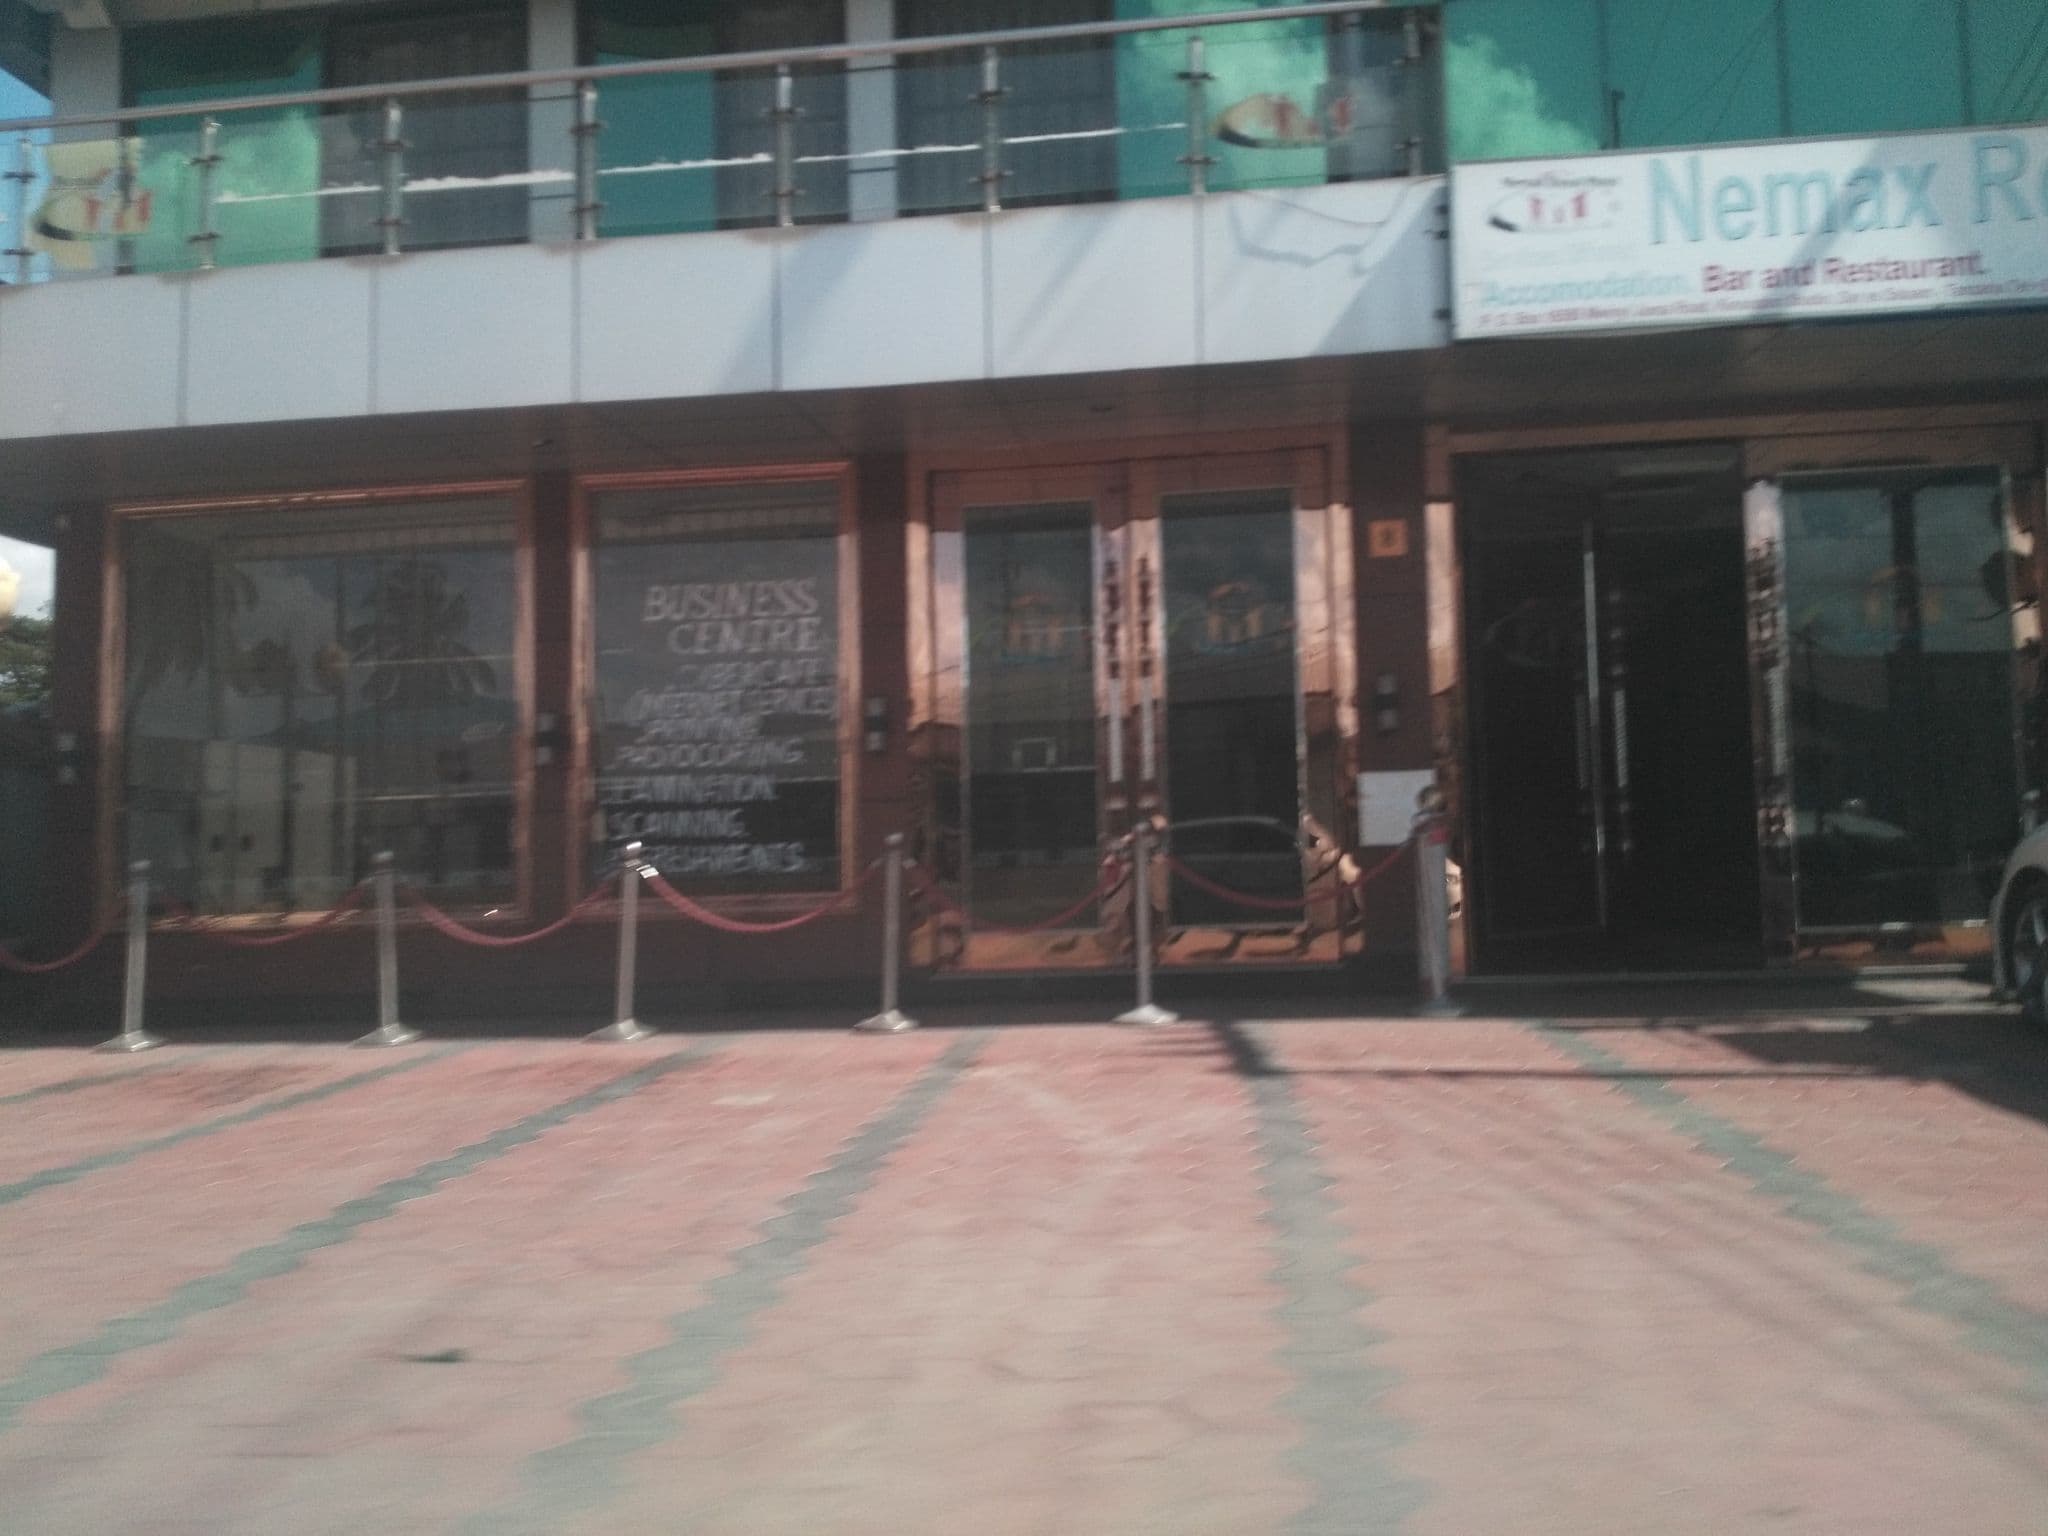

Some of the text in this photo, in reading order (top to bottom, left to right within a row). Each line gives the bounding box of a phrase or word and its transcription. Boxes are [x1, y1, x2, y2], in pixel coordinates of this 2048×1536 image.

[1648, 133, 2048, 246] Nemax R
[1702, 263, 1751, 293] Bar
[1759, 257, 1817, 290] and
[641, 576, 819, 623] BUSINESS
[666, 615, 823, 656] CENTRE
